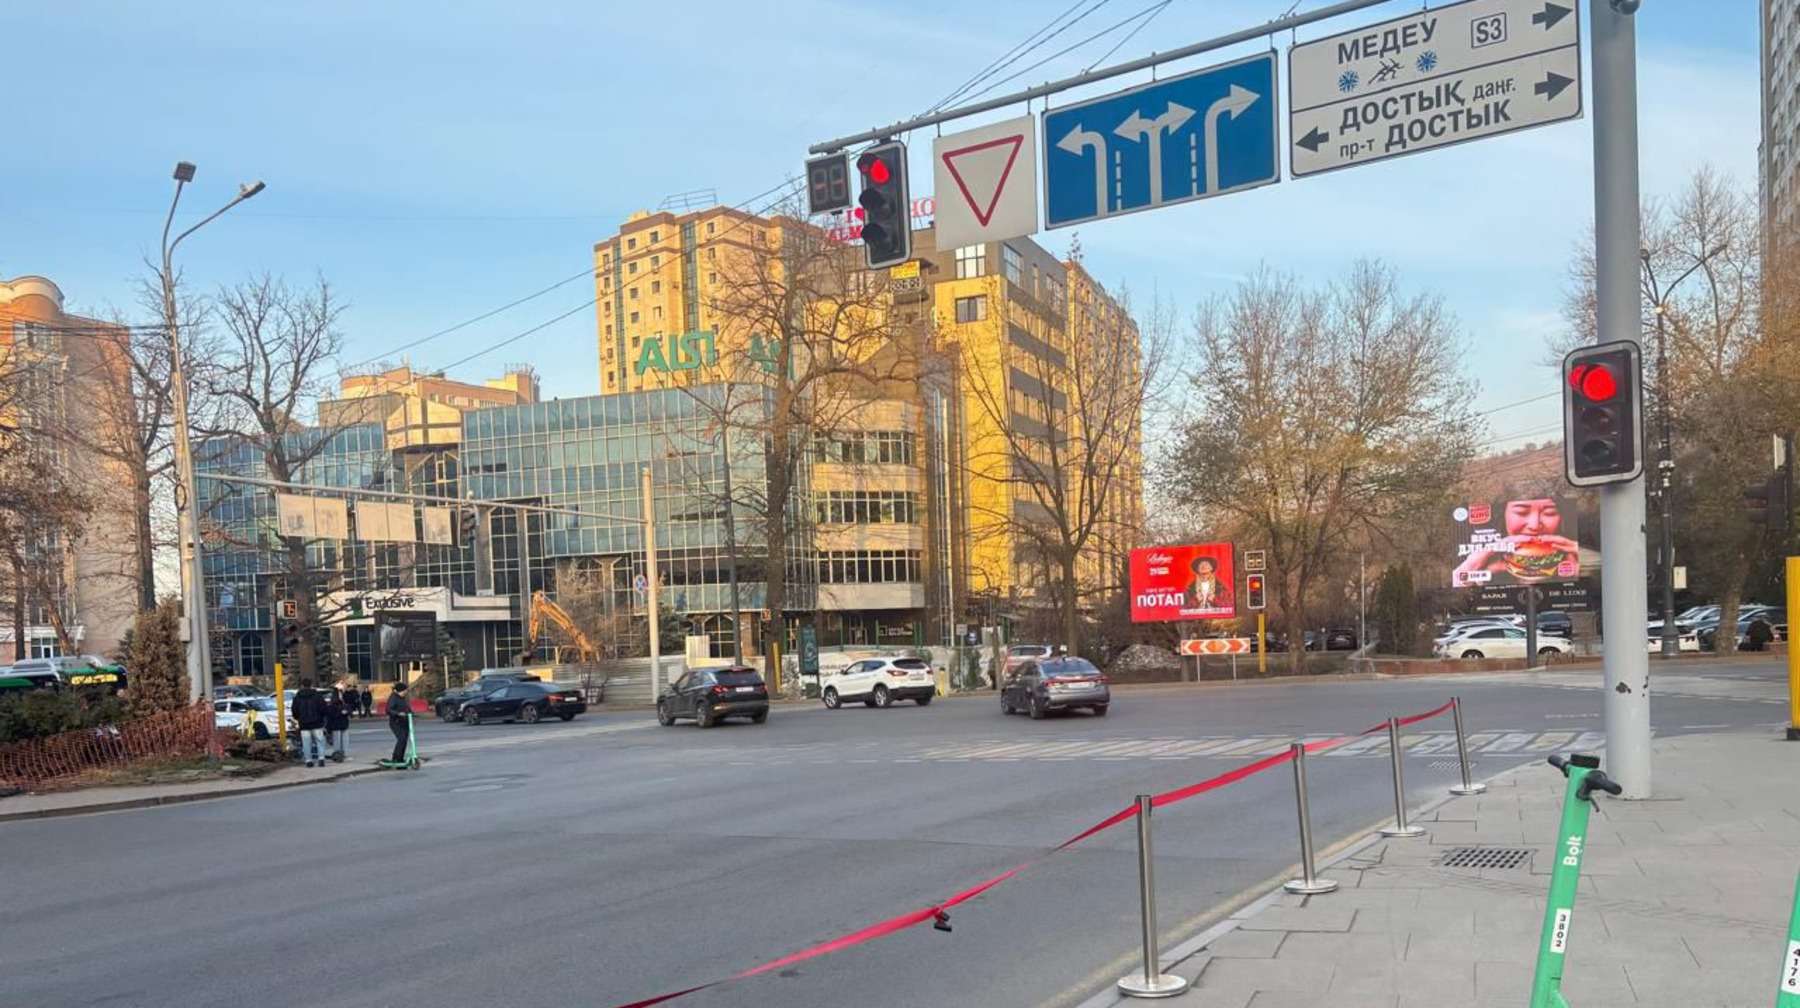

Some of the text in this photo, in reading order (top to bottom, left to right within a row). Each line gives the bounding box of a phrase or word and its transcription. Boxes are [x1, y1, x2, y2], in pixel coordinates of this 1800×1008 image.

[1338, 18, 1437, 64] МЕДЕУ
[1476, 19, 1503, 45] S3
[1340, 76, 1517, 135] ДОСТЫҚ даңғ.
[1340, 98, 1511, 160] пр-т ДОСТЫК
[367, 597, 414, 609] Exclusive
[1137, 593, 1185, 607] ПОТАП
[1564, 836, 1583, 866] Bolt
[1556, 915, 1567, 947] 3802
[1789, 949, 1800, 986] 4176
